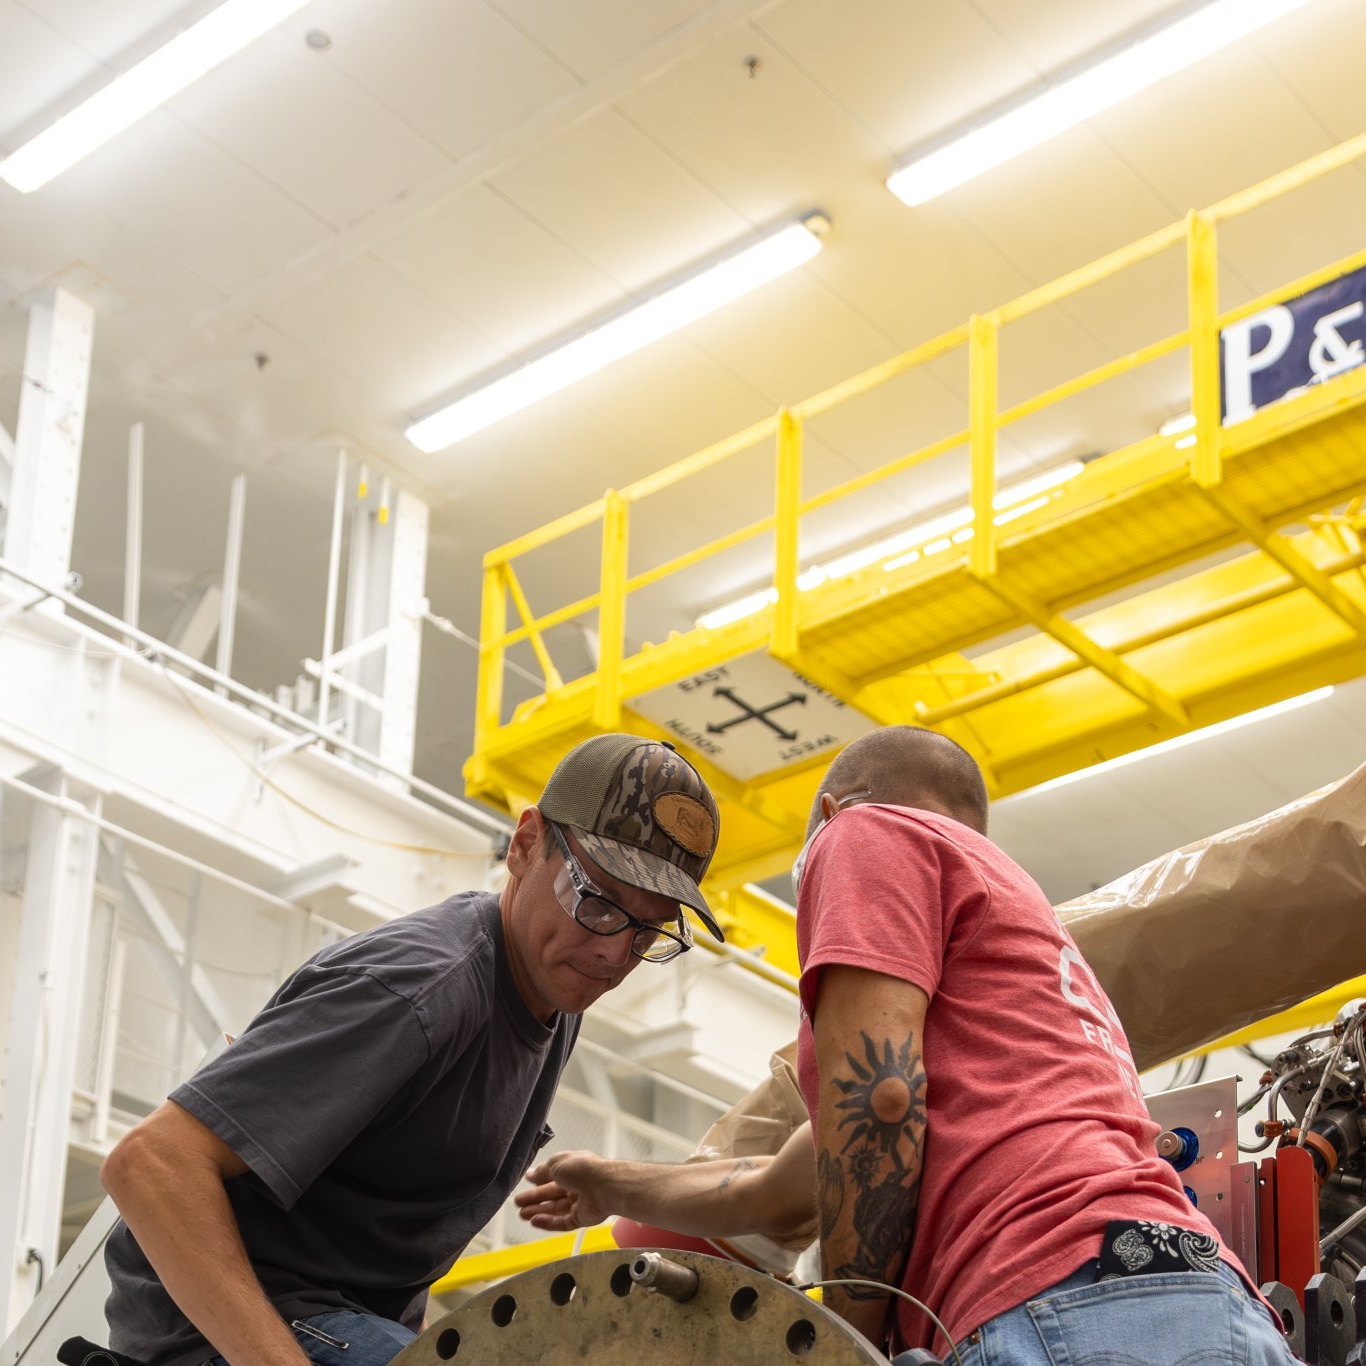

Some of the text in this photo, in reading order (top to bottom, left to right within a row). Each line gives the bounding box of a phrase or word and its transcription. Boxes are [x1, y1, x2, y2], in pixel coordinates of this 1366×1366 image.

[1221, 304, 1295, 428] P
[677, 666, 731, 693] EAST
[665, 717, 723, 756] SOUTH
